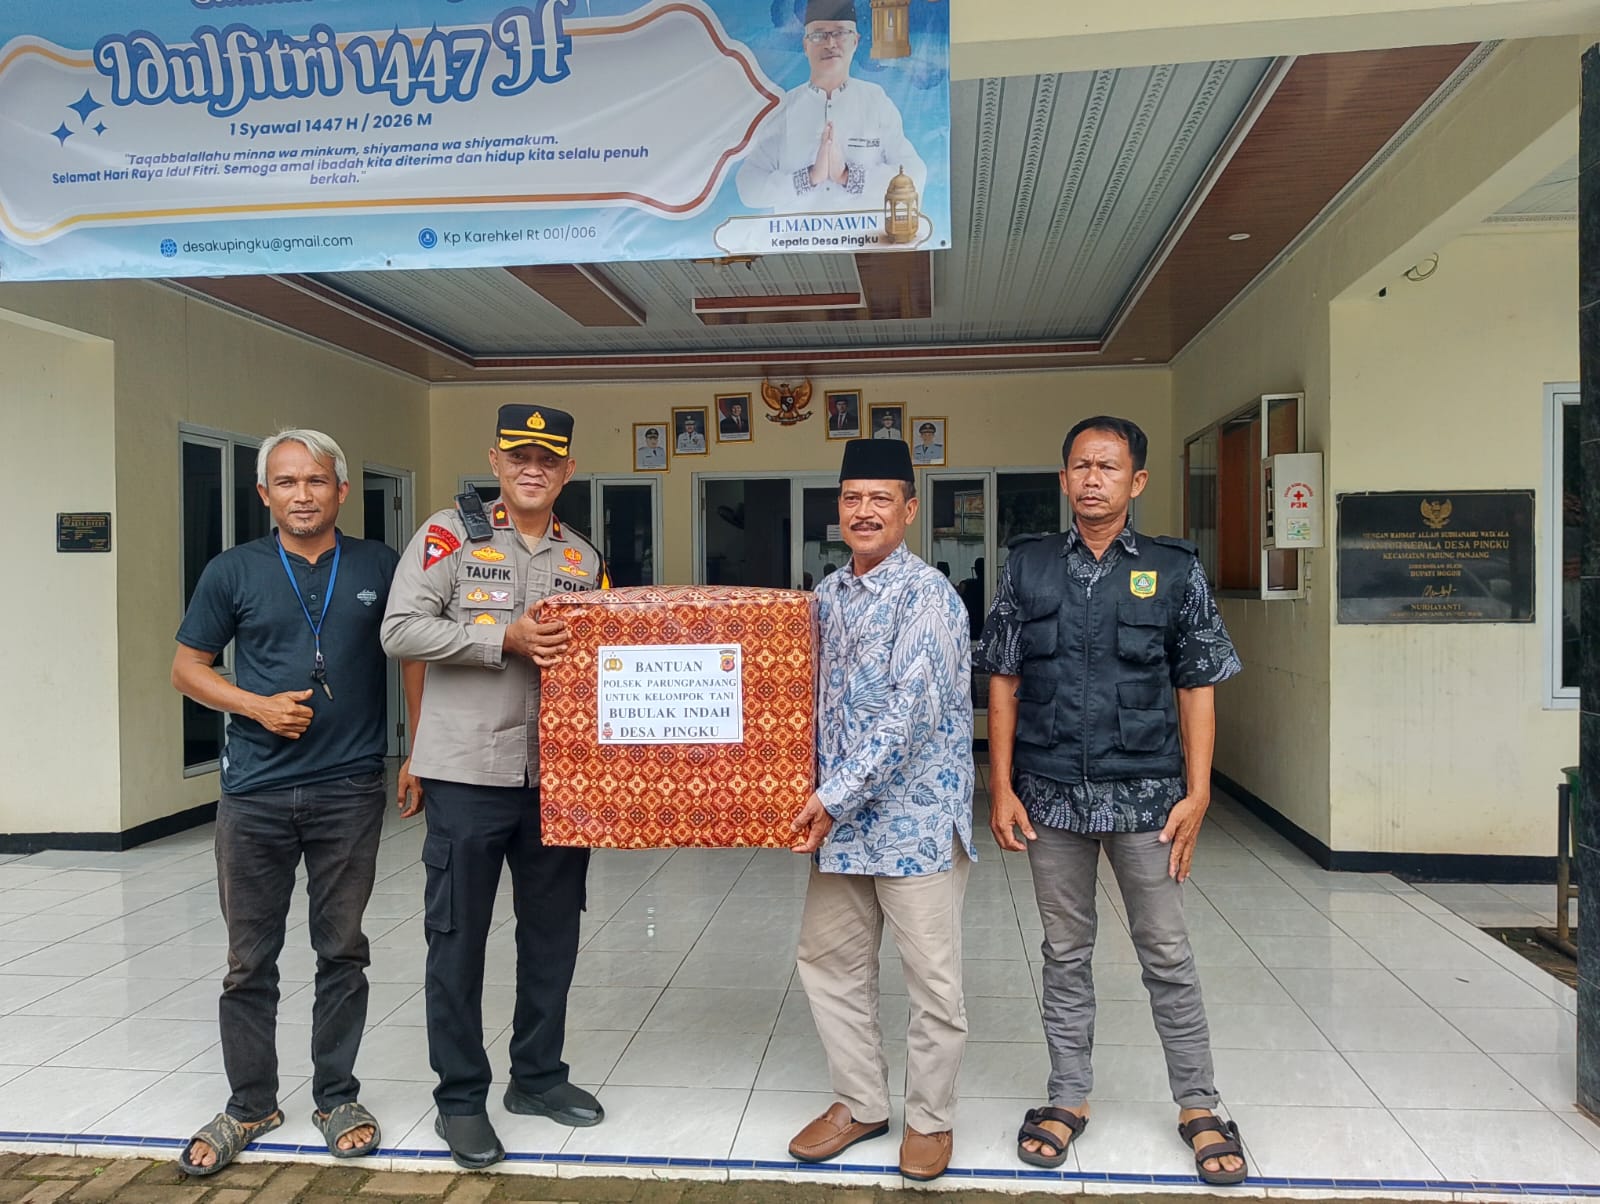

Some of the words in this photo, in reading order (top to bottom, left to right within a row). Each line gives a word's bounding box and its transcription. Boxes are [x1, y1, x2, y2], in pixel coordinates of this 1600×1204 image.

[96, 26, 340, 114] Idulfitri
[346, 30, 489, 103] 1447
[229, 123, 235, 136] 1
[239, 119, 301, 139] Syawal
[305, 117, 342, 132] 1447
[346, 117, 358, 130] H
[361, 113, 370, 132] /
[373, 113, 413, 129] 2026
[417, 112, 433, 126] M
[233, 149, 275, 161] minna
[279, 149, 297, 159] wa
[301, 146, 359, 158] minkum,
[363, 141, 438, 156] shiyamana
[442, 141, 460, 150] wa
[465, 134, 559, 150] shiyamakum.
[52, 171, 101, 184] Selamat
[104, 168, 129, 181] Hari
[131, 168, 163, 181] Raya
[166, 166, 190, 177] Idul
[193, 164, 220, 176] Fitri.
[223, 162, 277, 176] Semoga
[280, 159, 314, 172] amal
[317, 156, 364, 170] ibadah
[367, 154, 392, 168] kita
[395, 153, 452, 167] diterima
[456, 152, 482, 163] dan
[485, 149, 525, 165] hidup
[528, 147, 555, 161] kita
[558, 147, 600, 160] selalu
[603, 145, 649, 162] penuh
[310, 170, 366, 185] berkah."
[769, 215, 878, 233] H.MADNAWIN
[444, 231, 461, 246] Kp
[464, 229, 523, 243] Karehkel
[527, 229, 540, 240] Rt
[543, 224, 596, 240] 001/006
[772, 236, 809, 248] Kepala
[812, 236, 839, 246] Desa
[841, 234, 879, 247] Pingku
[182, 235, 354, 253] desakupingku@gmail.com
[1444, 540, 1470, 549] DESA
[1473, 540, 1509, 549] PINGKU
[466, 566, 511, 580] TAUFIK
[635, 660, 703, 673] BANTUAN
[603, 679, 642, 688] POLSEK
[647, 678, 737, 688] PARUNGPANJANG
[605, 693, 641, 702] UNTUK
[645, 692, 704, 701] KELOMPOK
[709, 691, 735, 700] TANI
[609, 707, 677, 719] BUBULAK
[684, 707, 730, 718] INDAH
[620, 726, 656, 738] DESA
[663, 726, 720, 737] PINGKU
